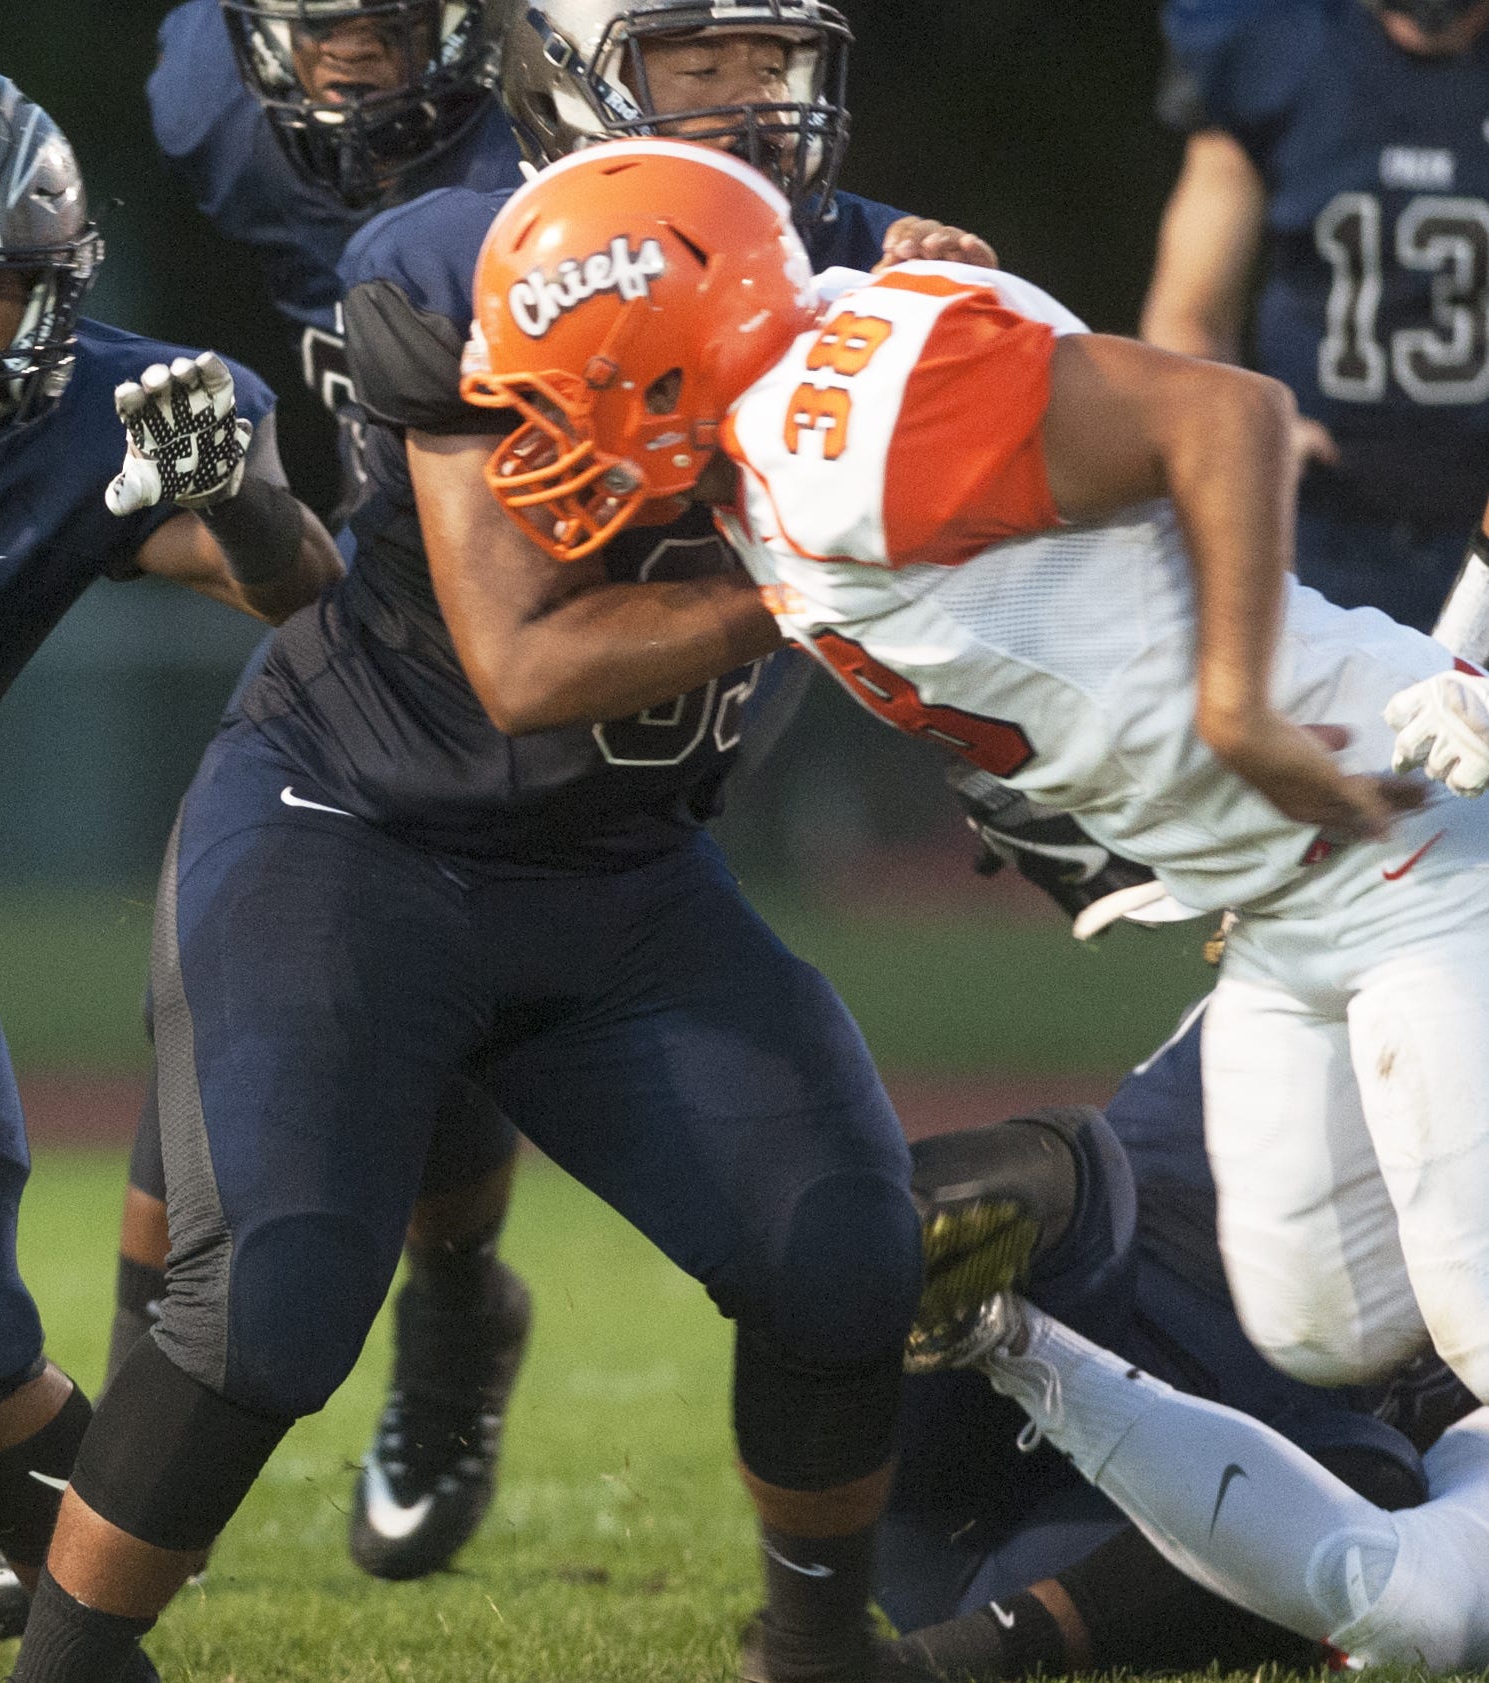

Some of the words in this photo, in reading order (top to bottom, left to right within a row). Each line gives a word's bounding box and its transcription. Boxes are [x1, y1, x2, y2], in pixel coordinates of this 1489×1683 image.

[508, 233, 666, 339] Chiefs
[1314, 192, 1489, 405] 13
[783, 310, 892, 461] 38
